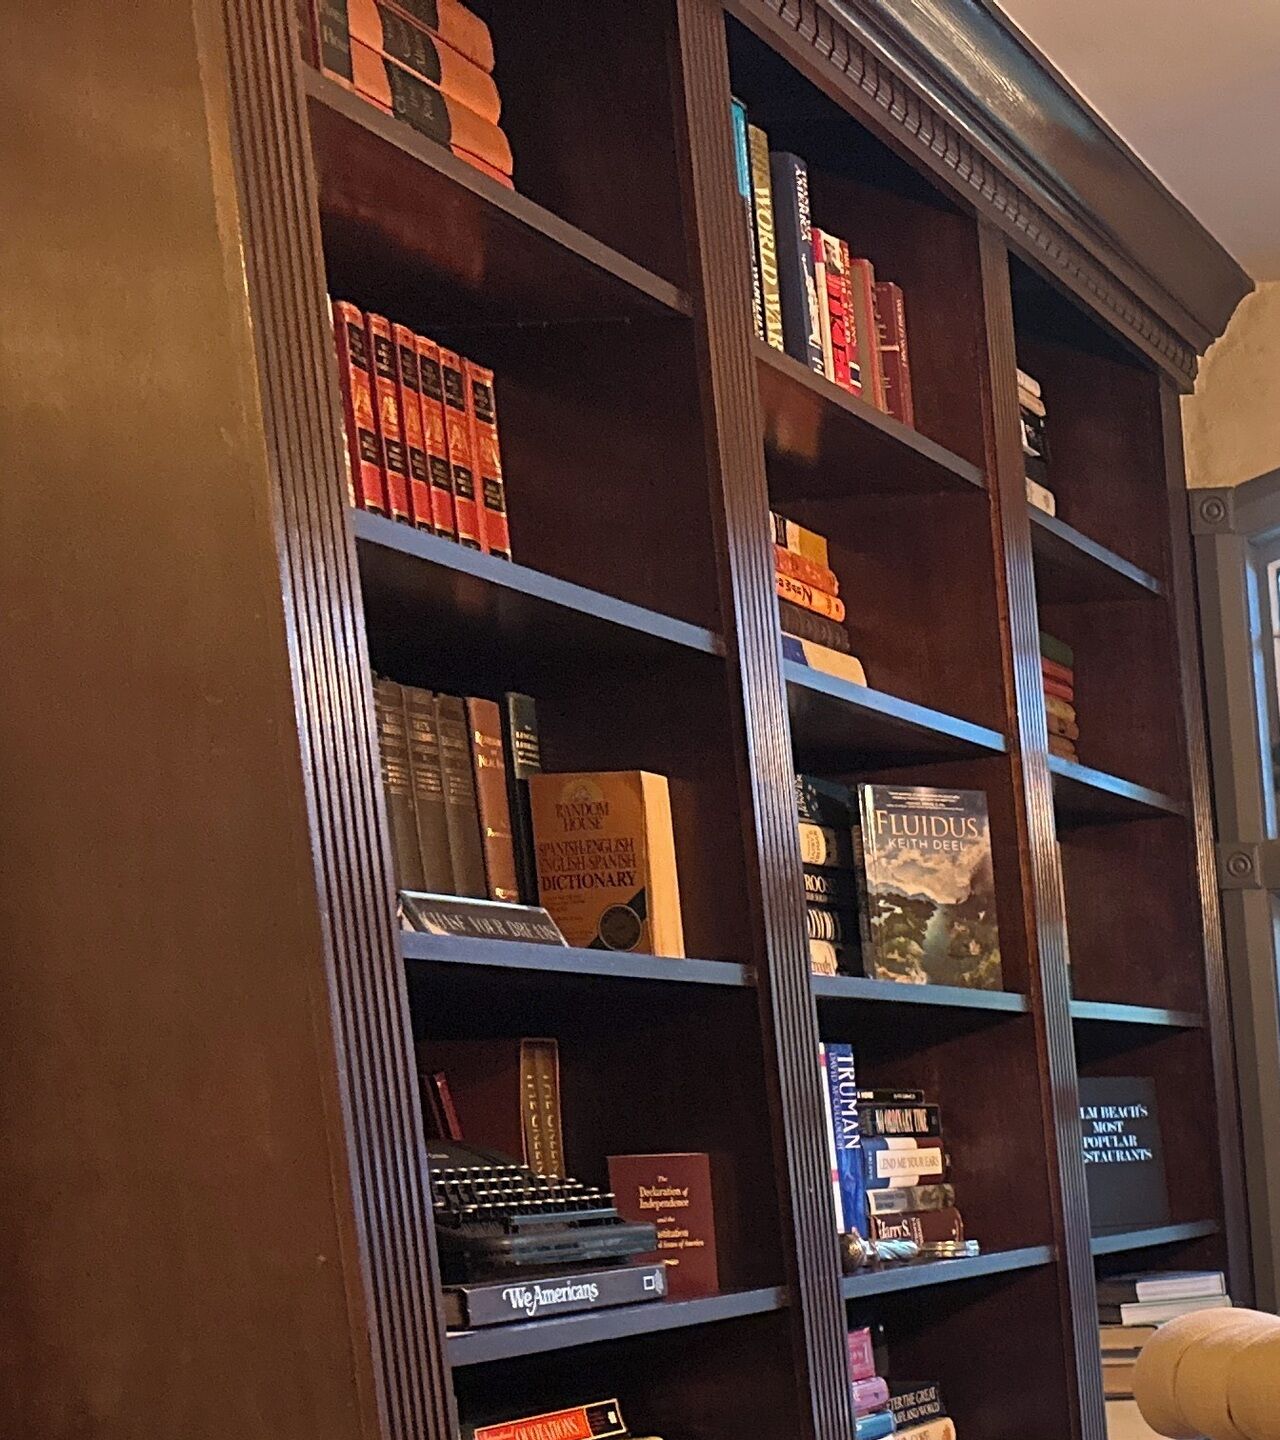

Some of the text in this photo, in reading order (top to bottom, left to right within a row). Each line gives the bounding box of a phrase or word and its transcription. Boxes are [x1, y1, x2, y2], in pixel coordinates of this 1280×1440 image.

[755, 187, 785, 352] WORLD WAR
[555, 802, 610, 818] RANDOM
[563, 816, 604, 832] HOUSE
[875, 810, 978, 839] FLUIDUS
[888, 838, 966, 852] KEITH DEEL
[541, 870, 637, 892] DICTIONARY
[829, 1052, 839, 1083] DAVID
[838, 1053, 861, 1150] TRUMAN
[1100, 1103, 1149, 1119] BEACH'S
[1093, 1120, 1124, 1134] MOST
[1083, 1134, 1138, 1149] POPULAR
[638, 1185, 681, 1198] Declaration
[639, 1197, 690, 1212] Independence
[502, 1280, 599, 1317] We Americans
[904, 1391, 916, 1406] THE
[916, 1386, 937, 1403] GREAT
